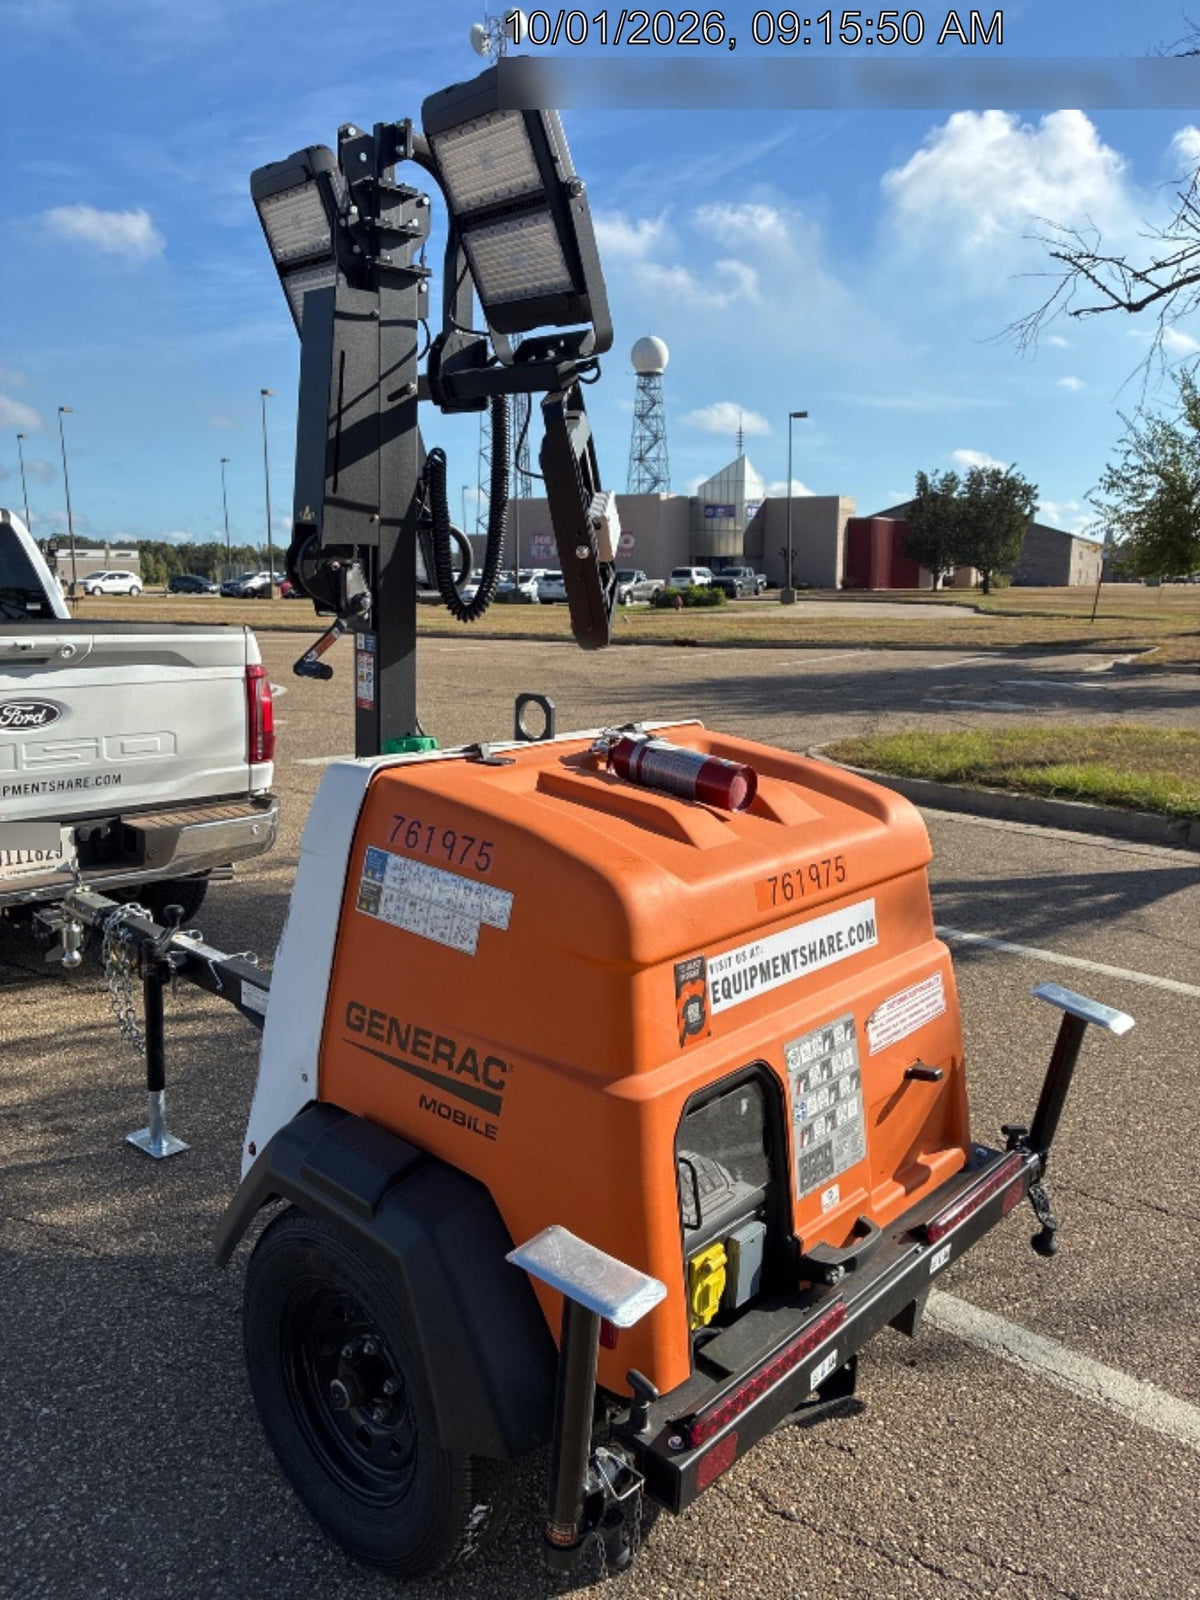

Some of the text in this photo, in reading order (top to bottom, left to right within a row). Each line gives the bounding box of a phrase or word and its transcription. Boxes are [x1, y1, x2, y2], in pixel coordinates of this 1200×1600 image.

[0, 705, 46, 725] Ford
[2, 774, 121, 797] PMENTSHARE.COM
[390, 814, 494, 871] 761975
[767, 855, 846, 905] 761975
[709, 956, 732, 975] VISIT
[735, 950, 747, 964] US
[711, 918, 875, 1004] EQUIPMENTSHARE.COM
[345, 1001, 508, 1090] GENERAC
[418, 1094, 499, 1141] MOBILE
